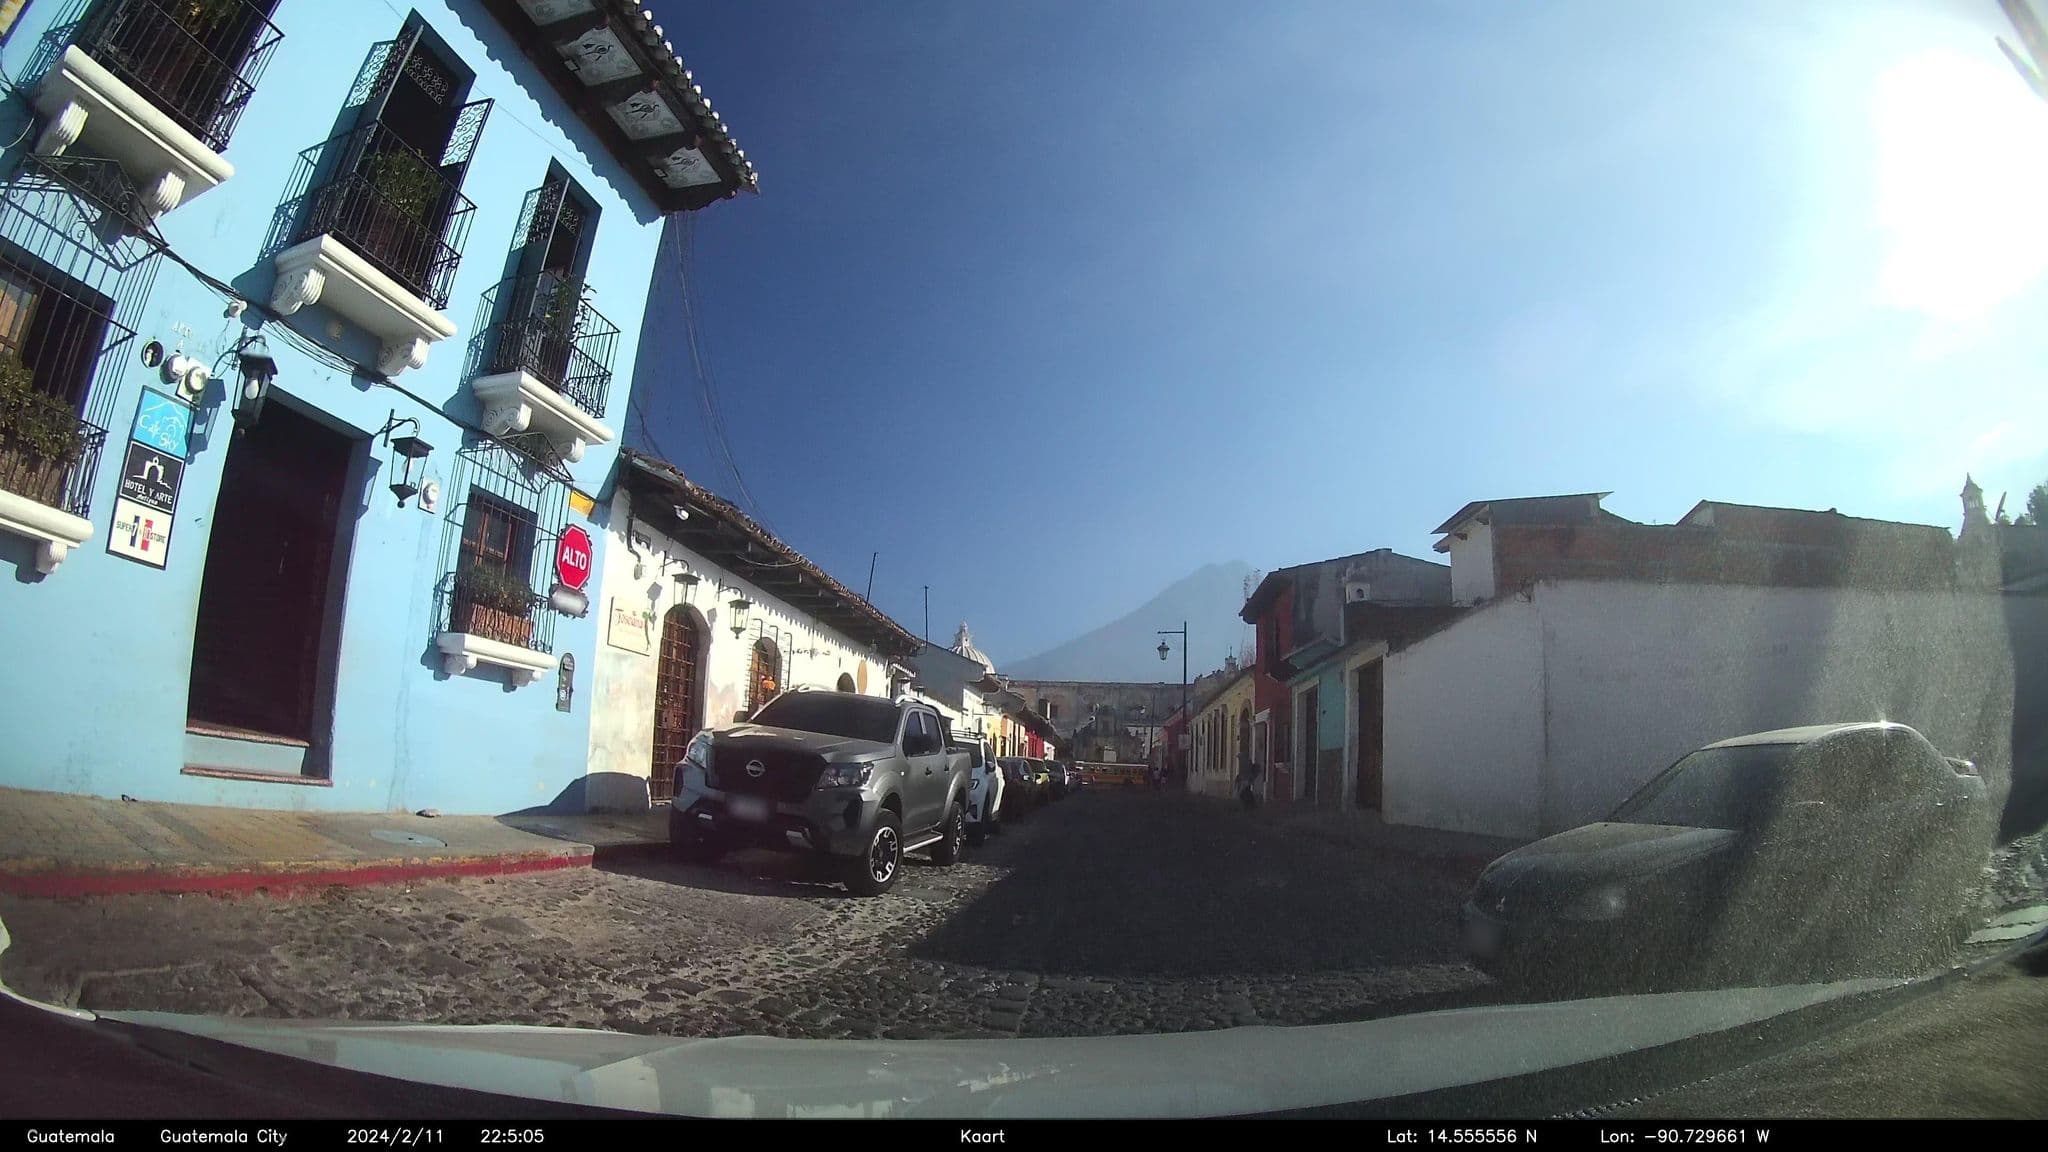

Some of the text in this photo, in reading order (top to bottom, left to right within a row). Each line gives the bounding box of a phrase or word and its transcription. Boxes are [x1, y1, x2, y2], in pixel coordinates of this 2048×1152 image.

[124, 479, 173, 504] HOTEL Y ARTE
[562, 545, 587, 571] ALTO
